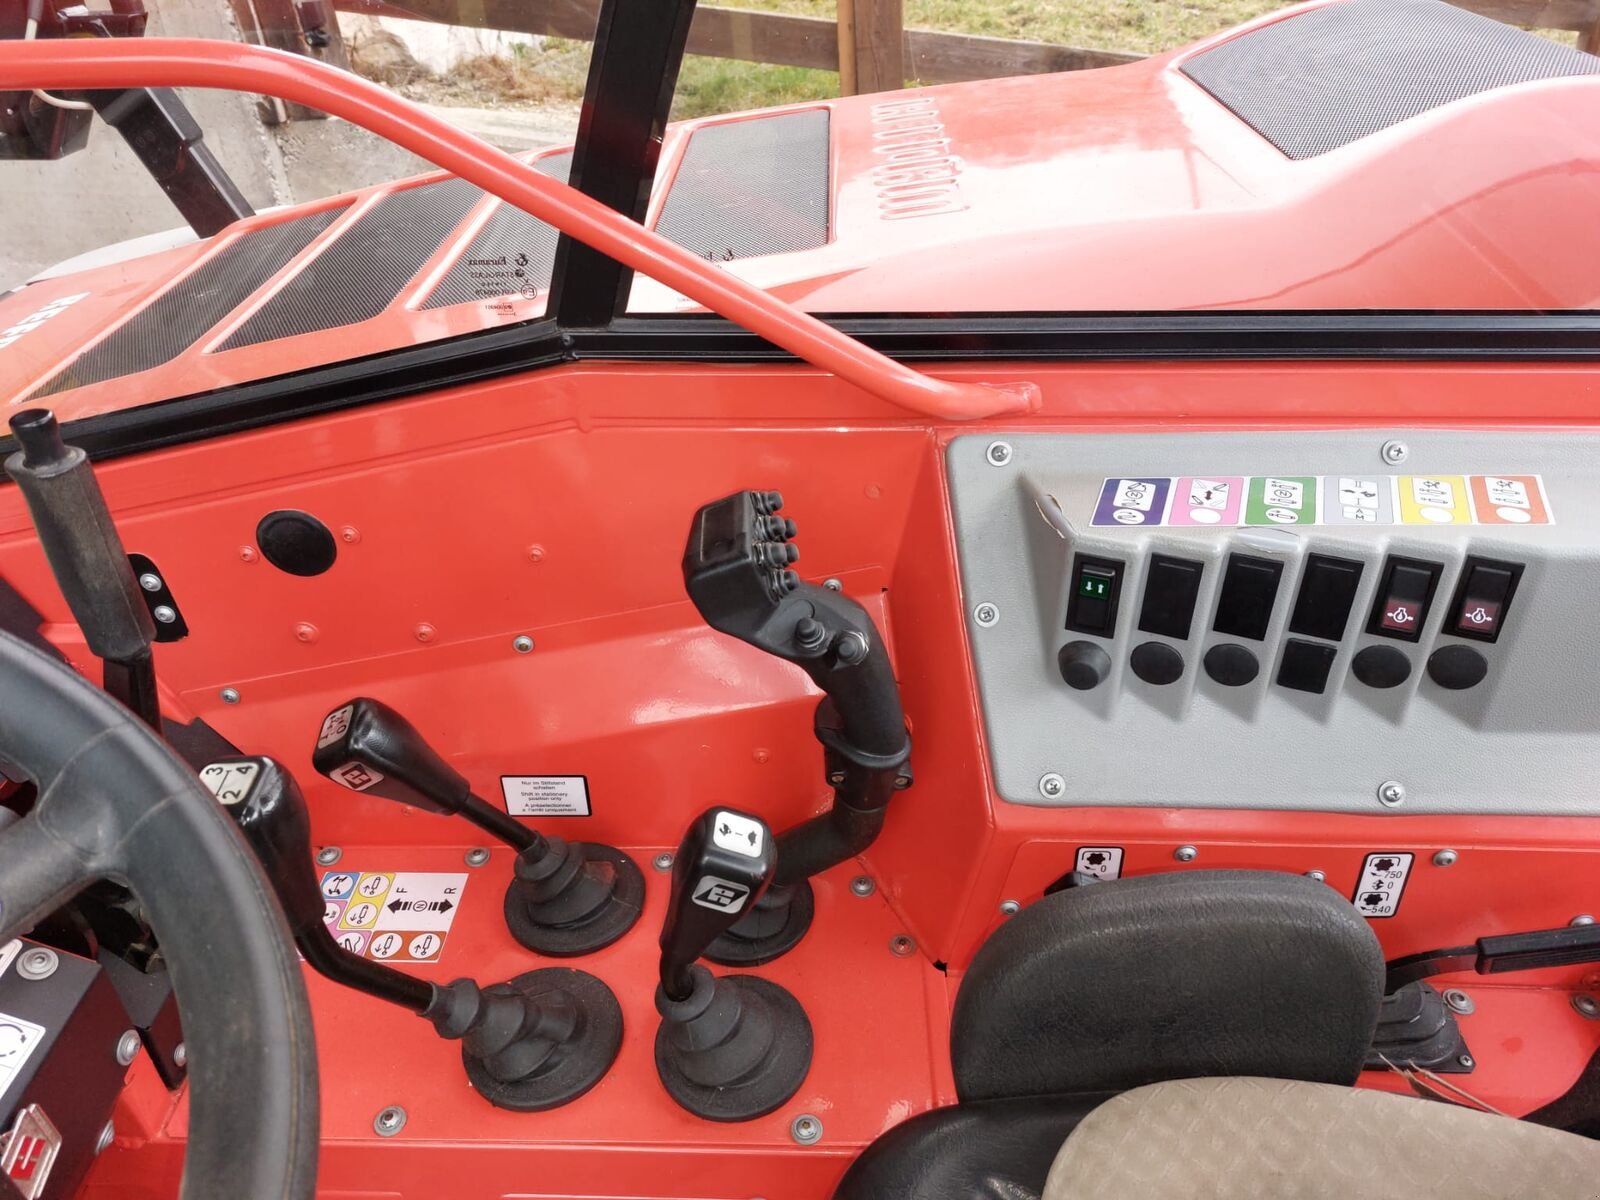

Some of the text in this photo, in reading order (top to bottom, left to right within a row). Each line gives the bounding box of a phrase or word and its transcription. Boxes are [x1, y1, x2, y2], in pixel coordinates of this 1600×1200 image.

[205, 766, 224, 776] 3
[236, 765, 253, 775] 4
[222, 789, 242, 799] 2
[1384, 870, 1403, 879] 750
[1387, 881, 1394, 889] 0
[1371, 905, 1391, 914] 540
